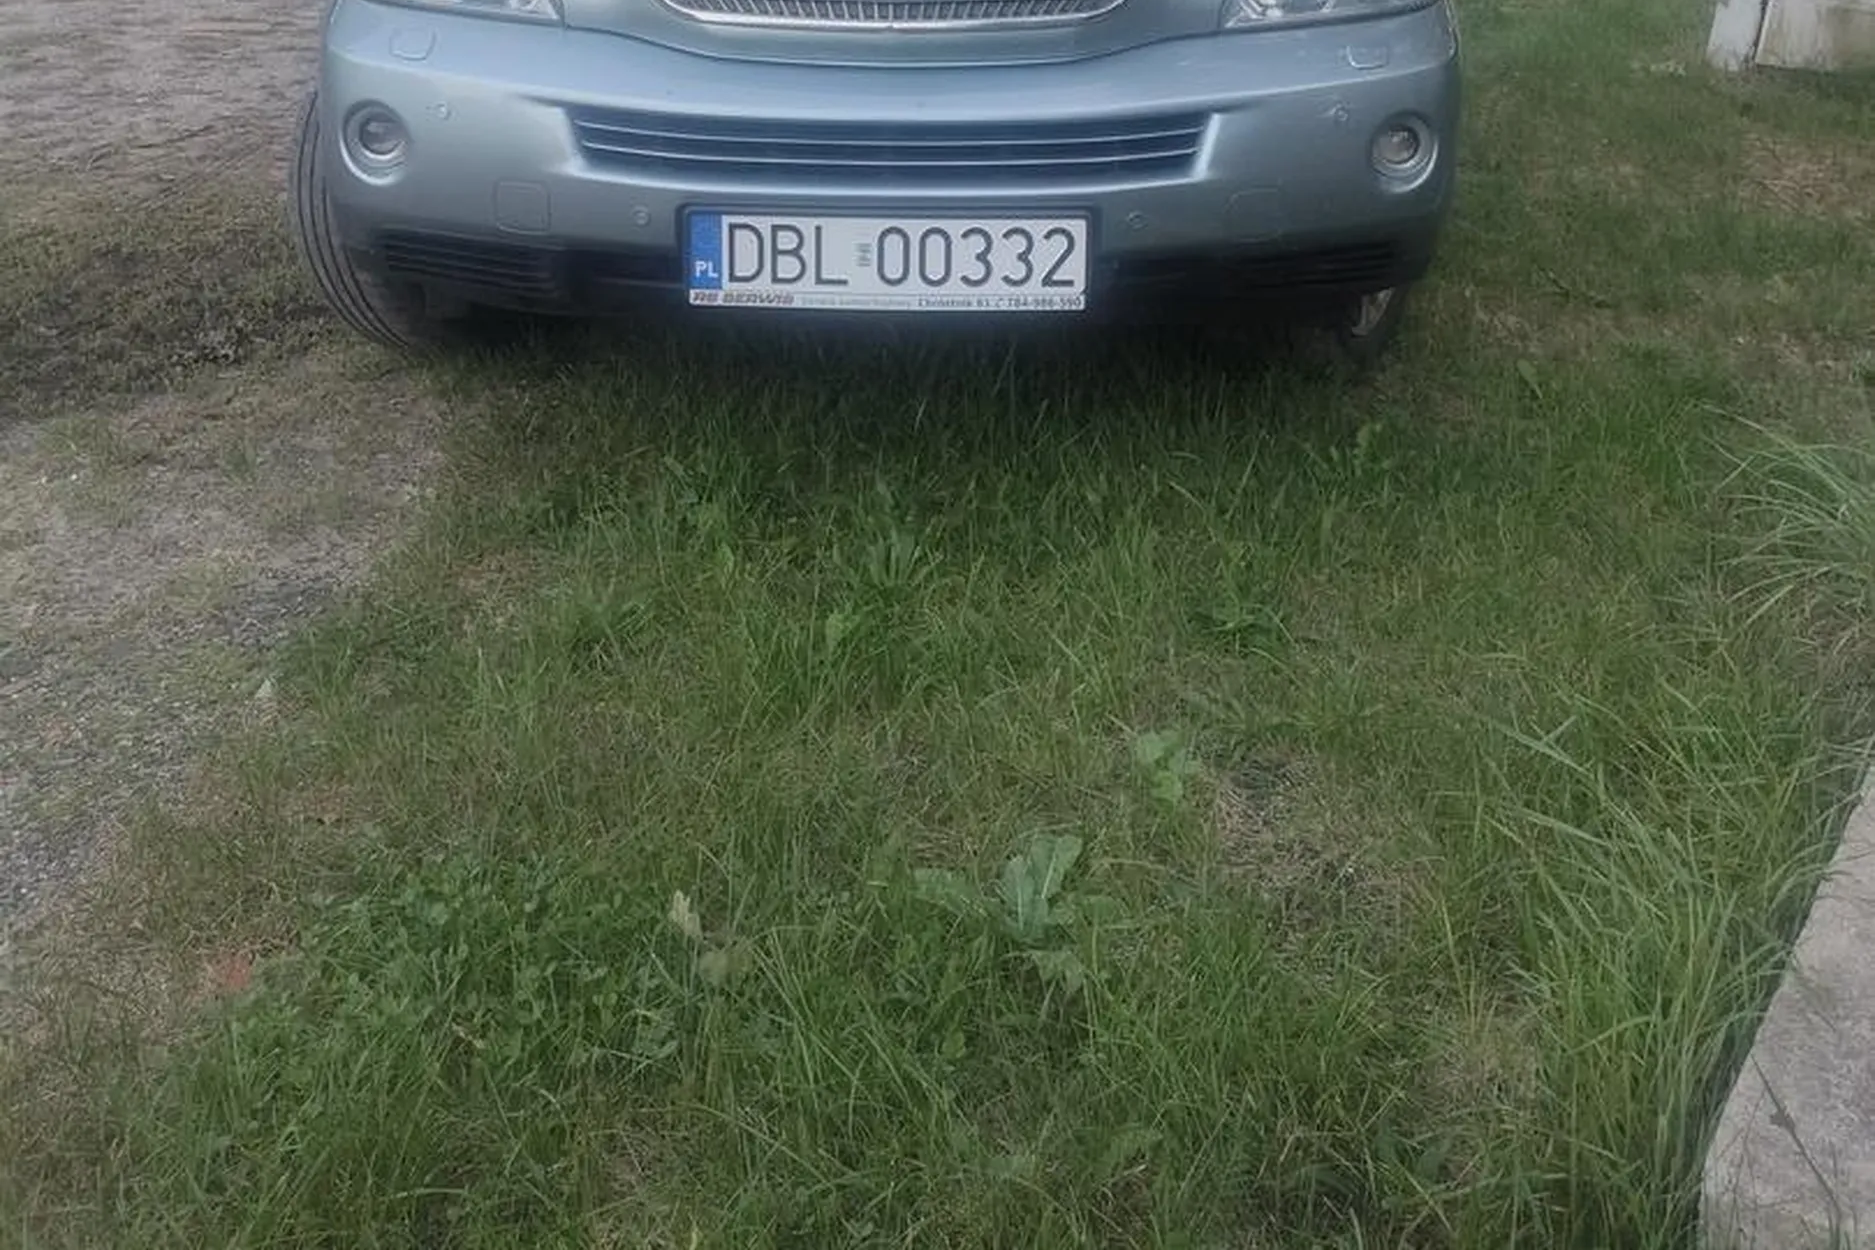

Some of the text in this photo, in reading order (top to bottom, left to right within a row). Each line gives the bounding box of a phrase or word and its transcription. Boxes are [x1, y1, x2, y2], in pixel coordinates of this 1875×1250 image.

[695, 261, 718, 278] PL
[729, 223, 1076, 287] DBL 00332
